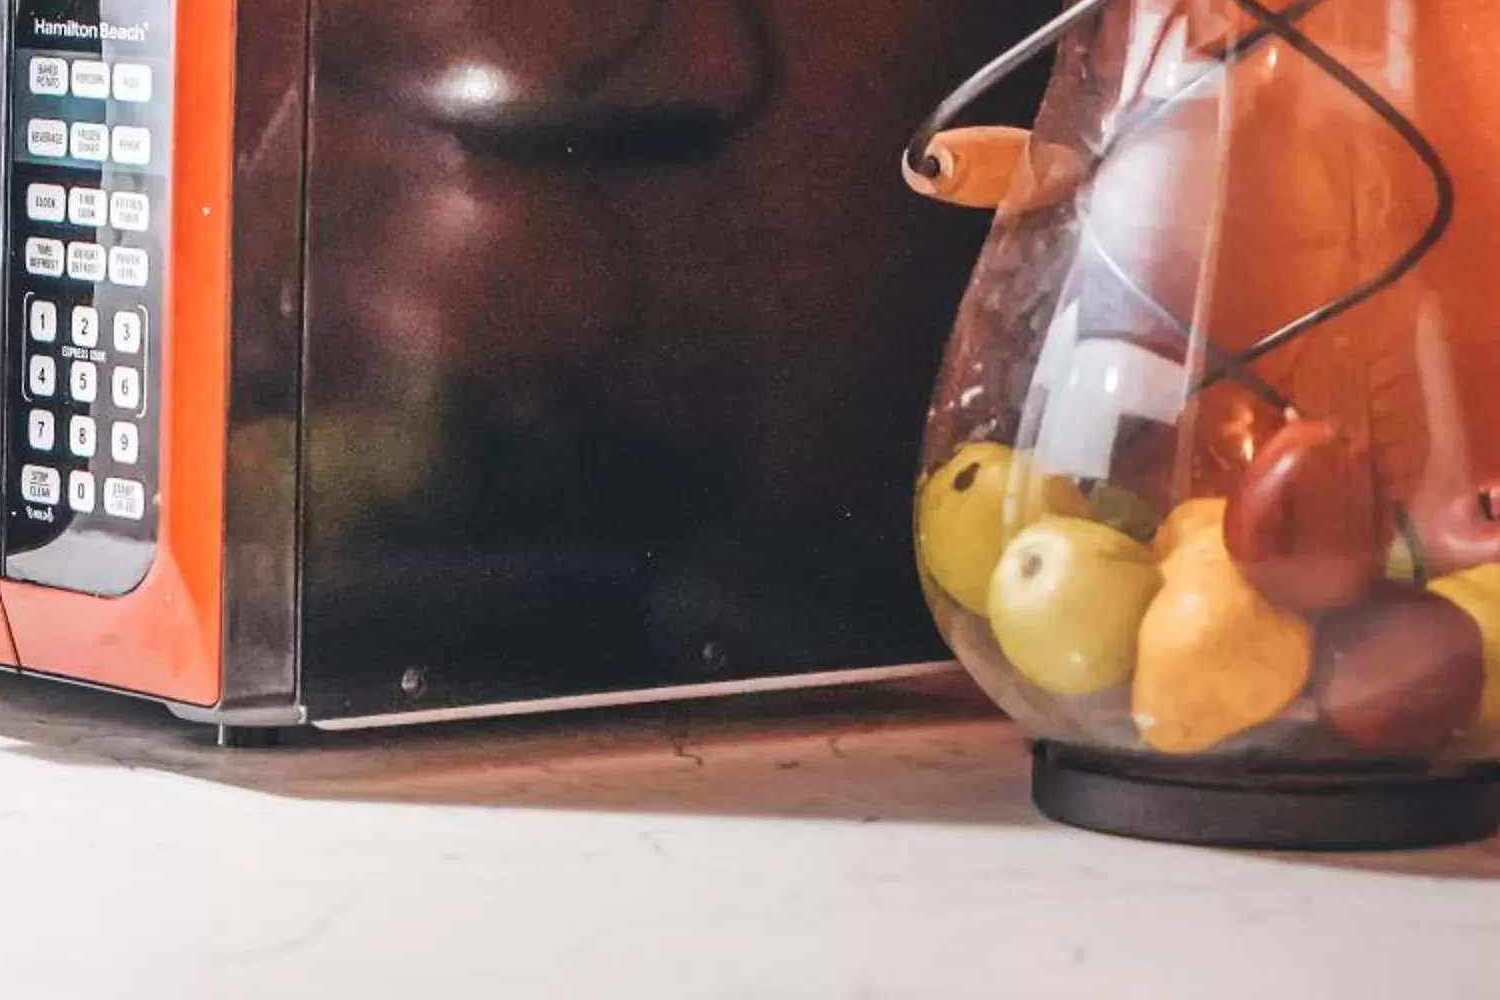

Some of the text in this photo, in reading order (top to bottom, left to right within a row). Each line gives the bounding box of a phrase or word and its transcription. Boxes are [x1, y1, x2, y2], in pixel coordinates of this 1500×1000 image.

[34, 18, 99, 39] Hamilton
[80, 318, 89, 336] 2
[122, 323, 131, 342] 3
[37, 367, 46, 384] 4
[79, 372, 87, 391] 5
[121, 378, 129, 396] 6
[37, 421, 45, 438] 7
[78, 427, 87, 445] 8
[120, 433, 129, 451] 9
[77, 483, 85, 500] 0
